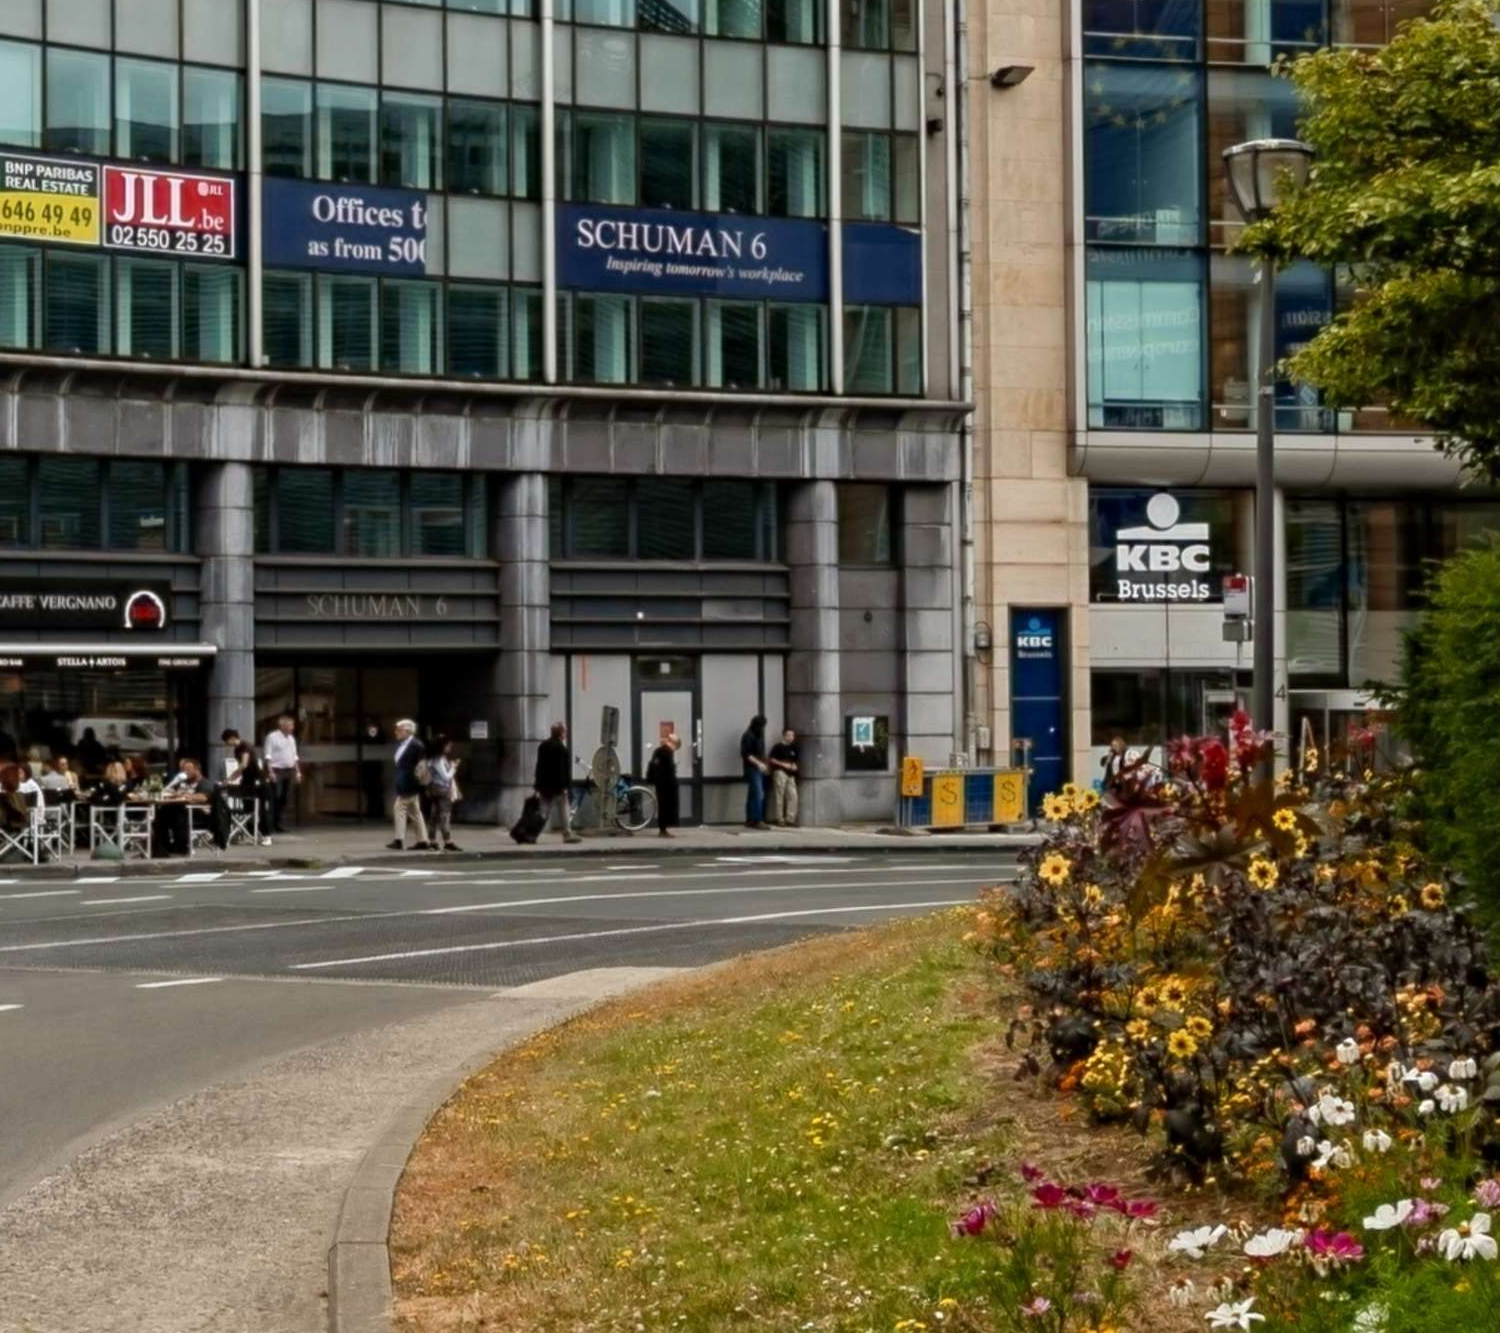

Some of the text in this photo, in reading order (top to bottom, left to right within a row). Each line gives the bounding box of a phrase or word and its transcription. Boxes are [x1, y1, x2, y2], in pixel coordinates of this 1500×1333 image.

[4, 161, 94, 182] BNP PARIBAS
[5, 175, 89, 196] REAL ESTATE
[2, 199, 35, 222] 646
[42, 203, 63, 225] 49
[70, 206, 92, 227] 49
[312, 195, 428, 229] Offices t
[112, 225, 225, 253] 02 550 25 25
[308, 240, 328, 256] as
[334, 237, 382, 260] from
[577, 218, 767, 260] SCHUMAN 6
[605, 255, 804, 285] Inspiring tomorrow's workplace
[1116, 544, 1211, 572] KBC
[1117, 579, 1211, 599] Brussels
[39, 595, 117, 610] VERGNANO
[306, 595, 448, 617] SCHUMAN 6
[1017, 636, 1052, 648] KBC
[56, 657, 88, 667] STELLA
